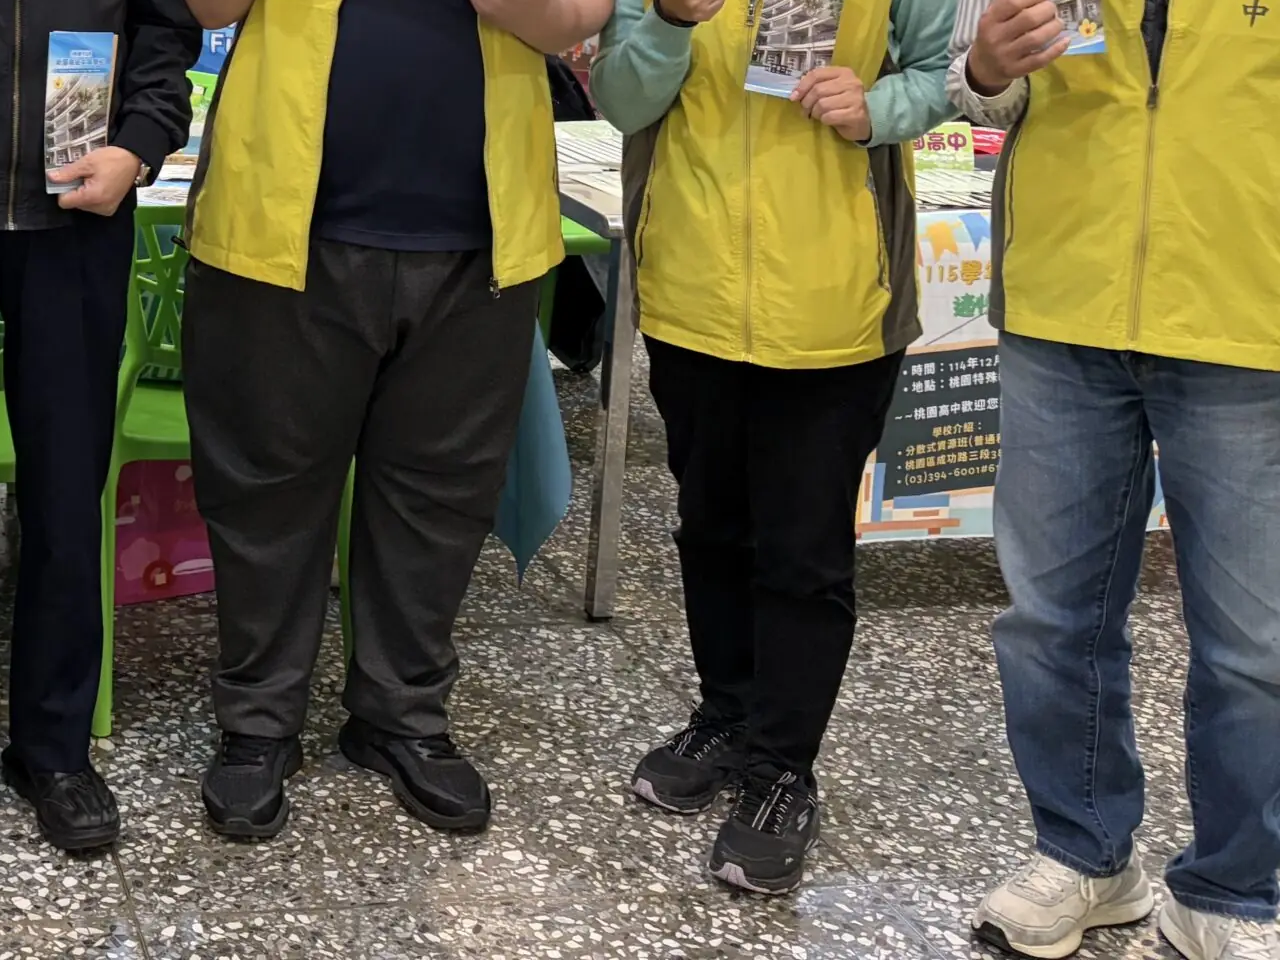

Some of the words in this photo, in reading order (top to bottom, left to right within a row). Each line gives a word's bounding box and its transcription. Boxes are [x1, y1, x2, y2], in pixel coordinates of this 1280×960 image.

[911, 371, 1000, 393] 地點：桃園特殊
